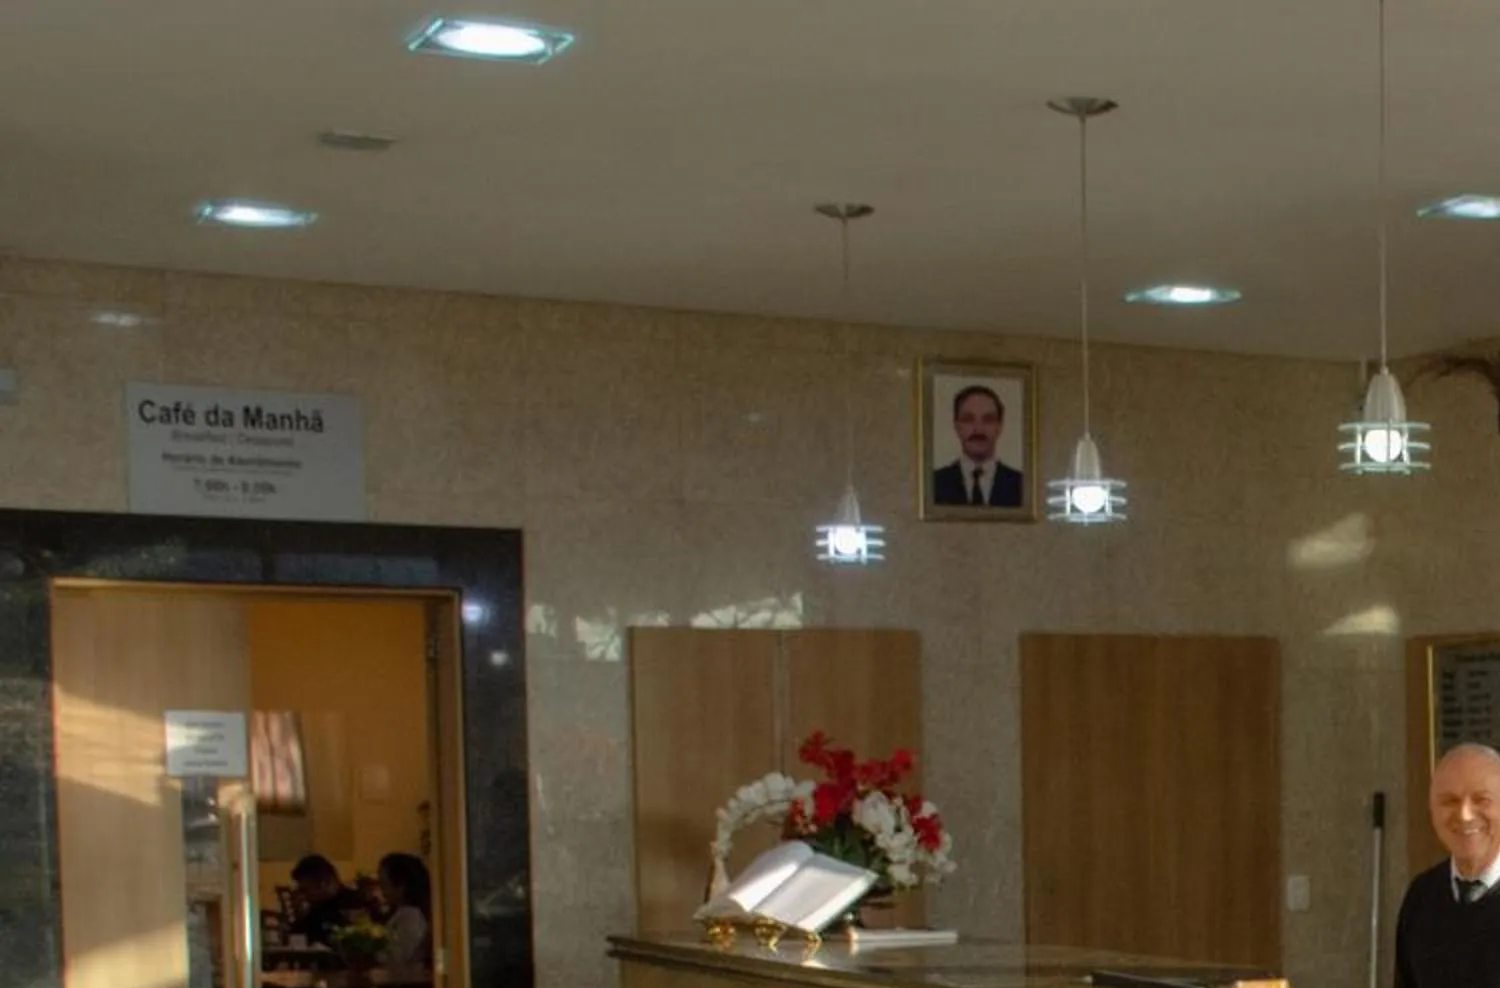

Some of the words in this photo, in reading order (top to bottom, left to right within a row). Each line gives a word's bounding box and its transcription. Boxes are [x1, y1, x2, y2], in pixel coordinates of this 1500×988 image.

[138, 399, 196, 426] Café
[205, 404, 234, 428] da
[243, 406, 324, 433] Manhã
